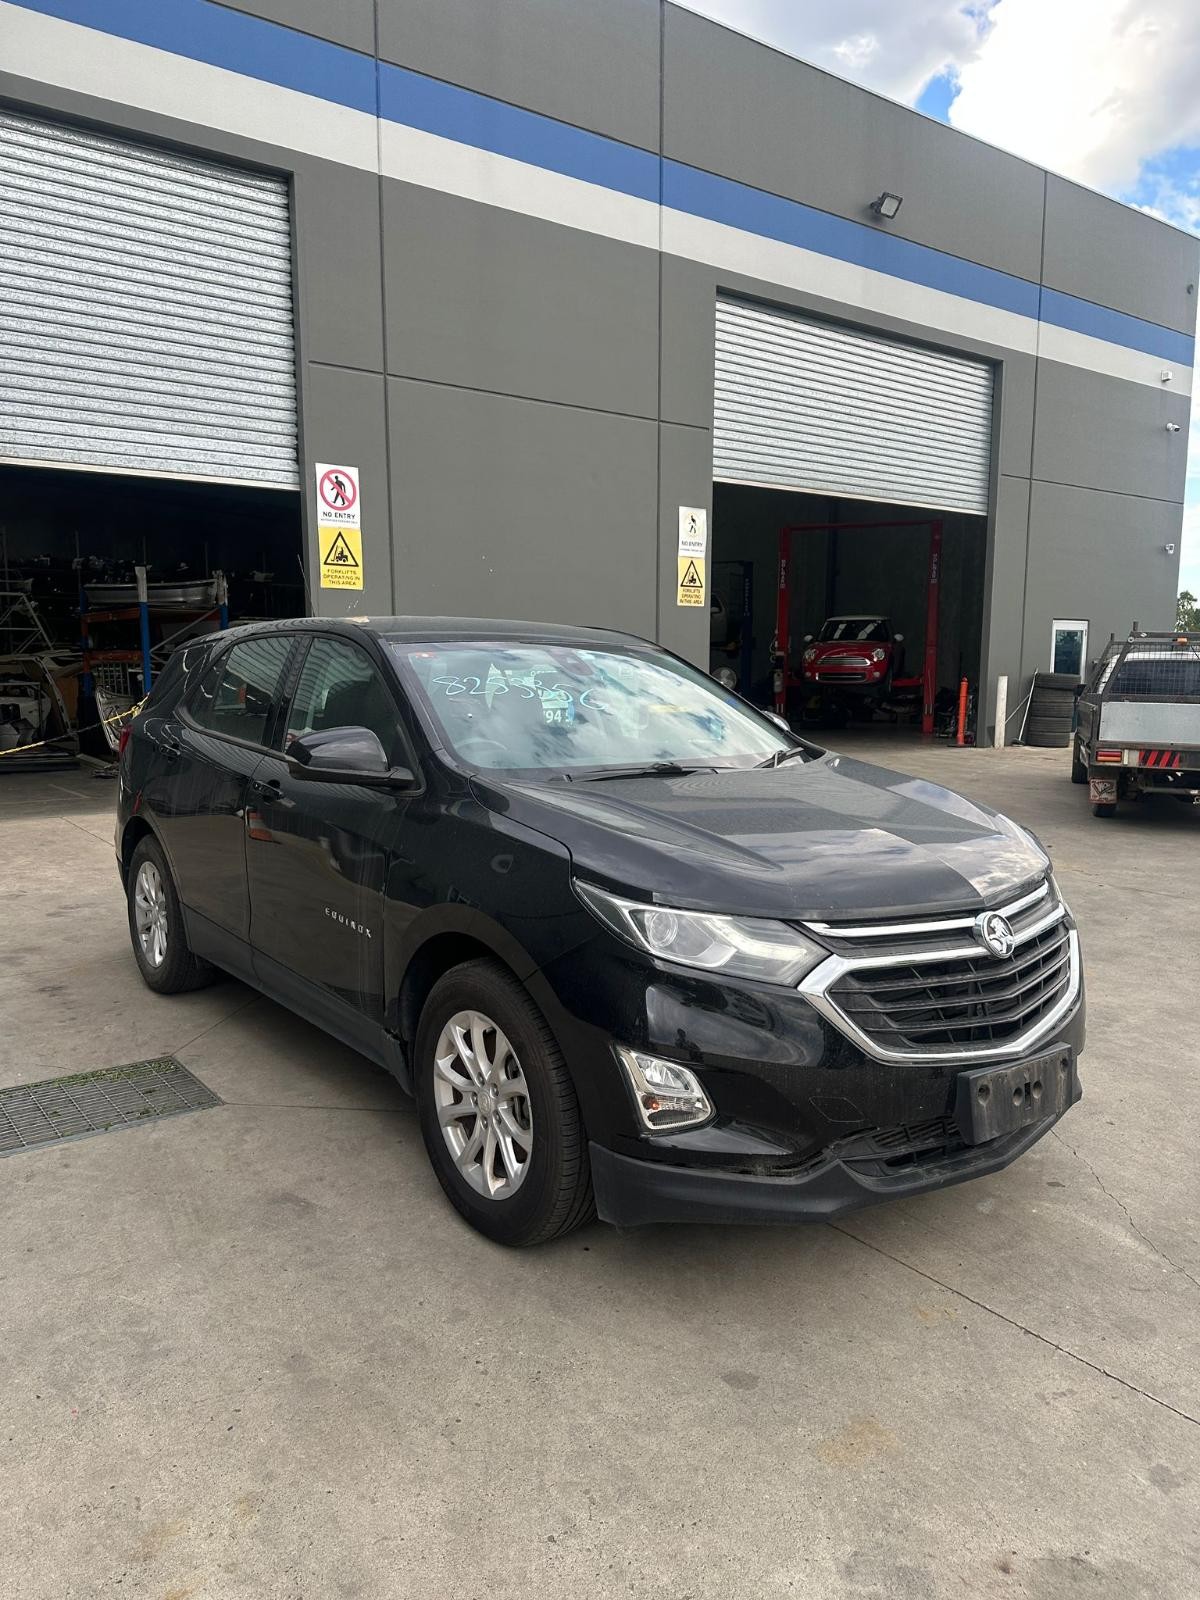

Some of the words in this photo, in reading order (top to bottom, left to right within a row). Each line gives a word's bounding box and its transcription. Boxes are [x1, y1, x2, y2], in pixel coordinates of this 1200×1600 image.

[334, 512, 356, 520] ENTRY
[323, 573, 354, 581] OPERATING
[324, 906, 372, 939] EQUINOX
